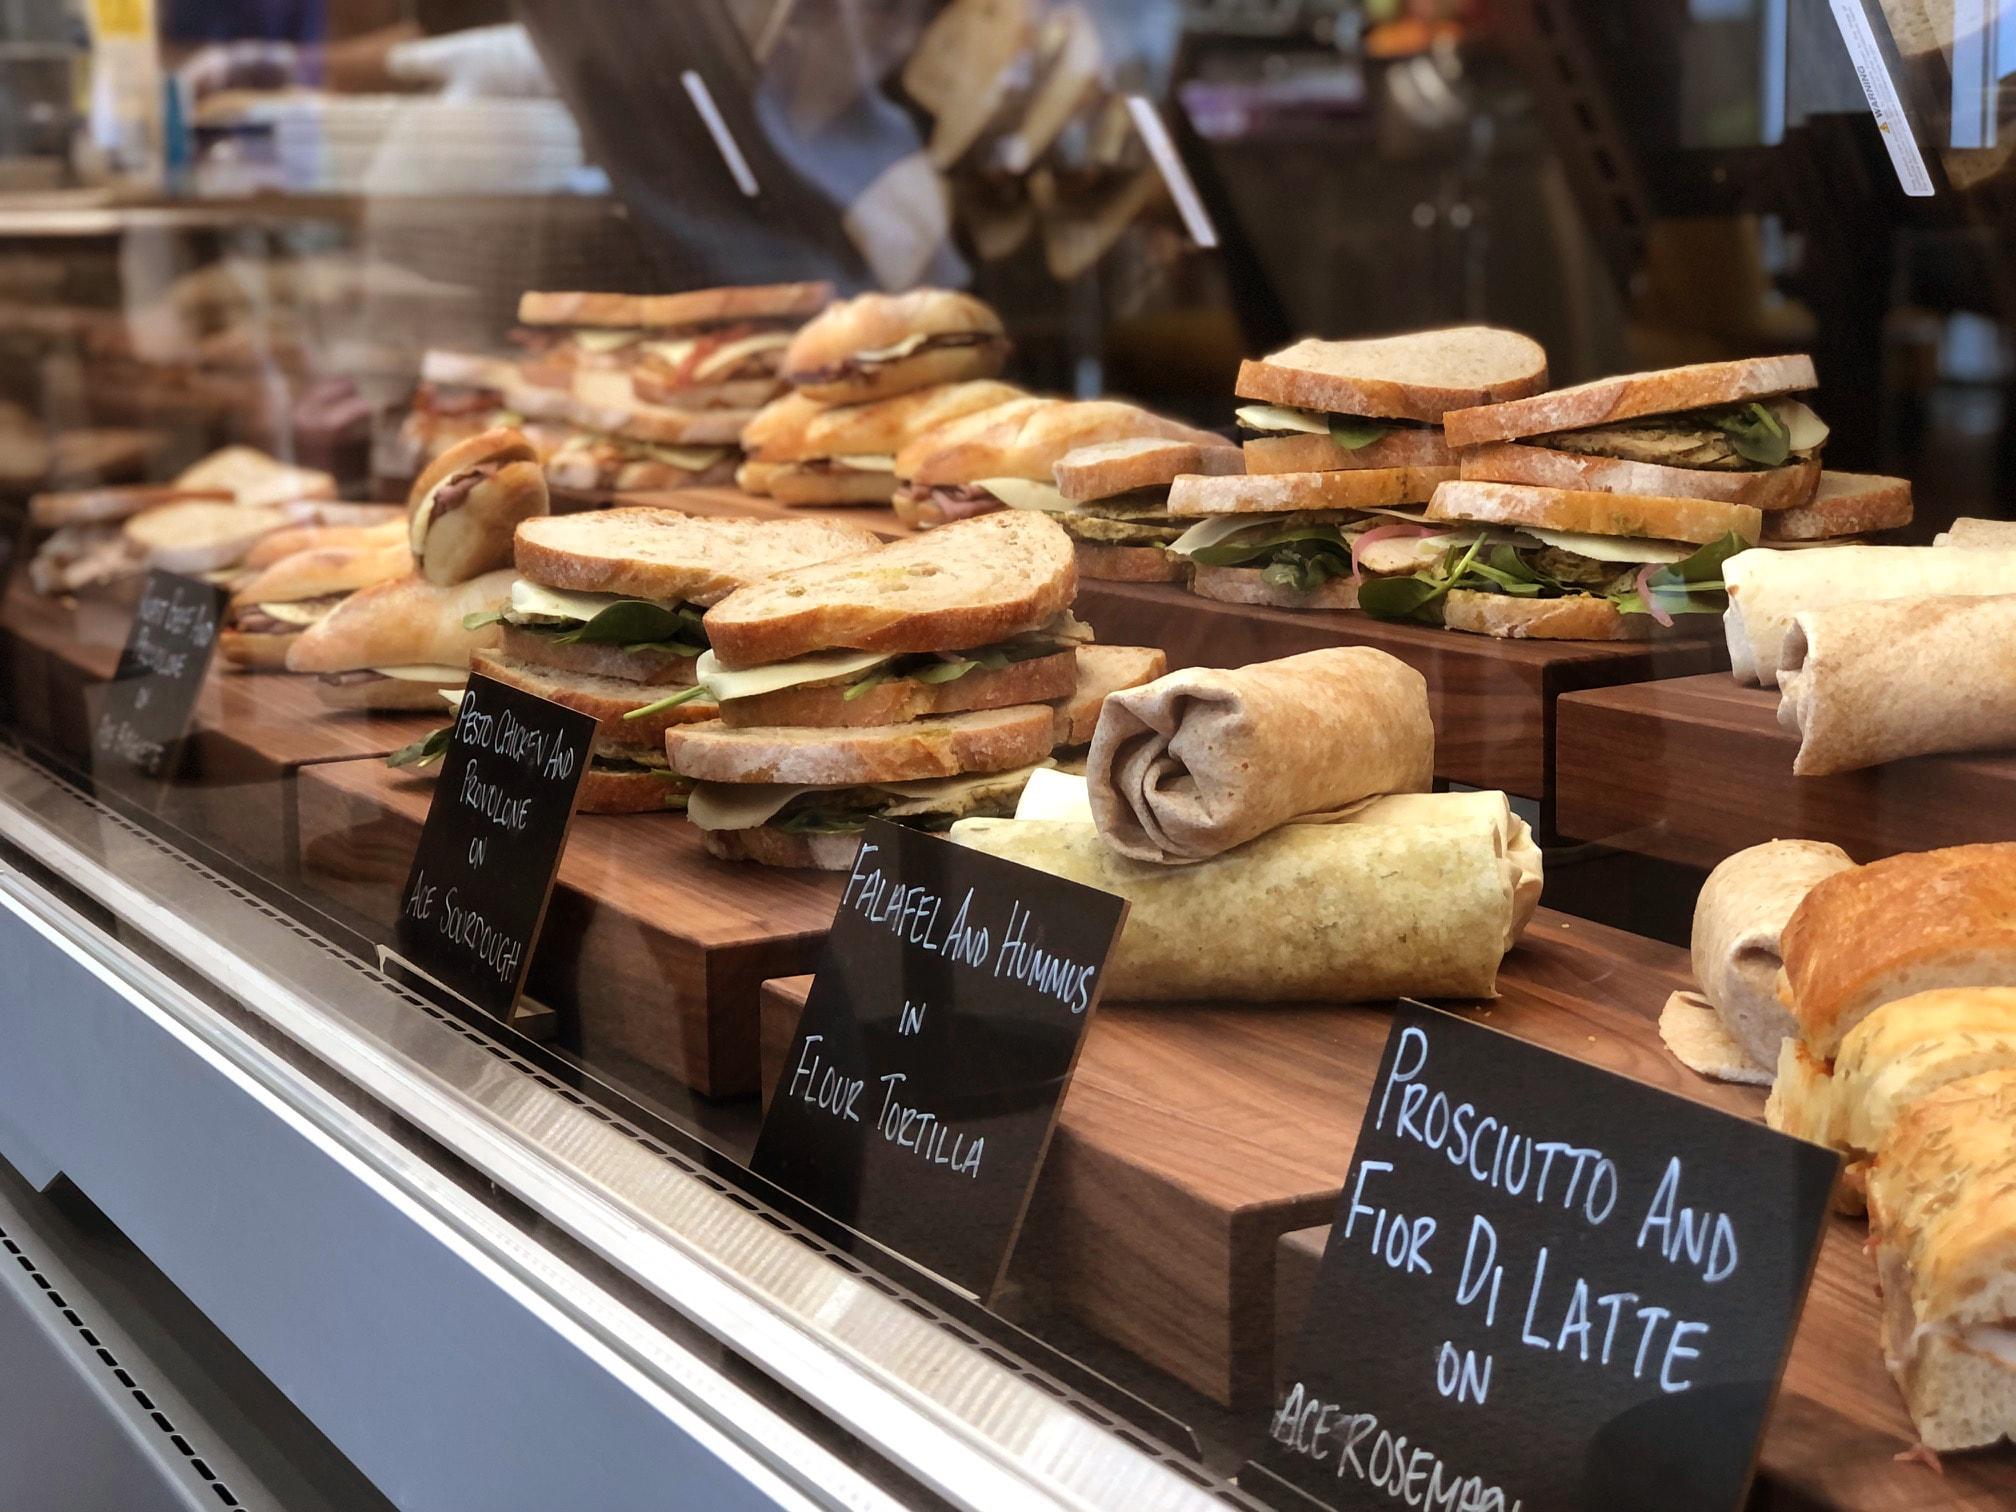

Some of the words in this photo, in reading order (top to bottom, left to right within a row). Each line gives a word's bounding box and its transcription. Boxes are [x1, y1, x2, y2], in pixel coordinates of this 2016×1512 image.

[1857, 65, 1883, 118] WARNING
[455, 690, 494, 748] PESTO
[494, 709, 550, 766] CHICKEN
[543, 728, 575, 781] AND
[460, 758, 532, 830] PROVOLONE
[468, 837, 488, 869] ON
[406, 869, 437, 920] ACE
[440, 886, 522, 983] SOURDOUGH
[842, 842, 942, 951] FALAFEL
[941, 887, 990, 968] AND
[994, 900, 1095, 1015] HUMMUS
[898, 1000, 927, 1036] IN
[789, 1035, 865, 1122] FLOUR
[876, 1072, 985, 1178] TORTILLA
[1375, 1027, 1618, 1225] PROSCIUTTO
[1637, 1156, 1739, 1282] AND
[1344, 1160, 1437, 1275] FIOR
[1456, 1214, 1503, 1326] DI
[1521, 1248, 1709, 1393] LATTE
[1436, 1341, 1492, 1403] ON
[1272, 1382, 1341, 1460] ACE
[1337, 1413, 1522, 1512] ROSEMA
